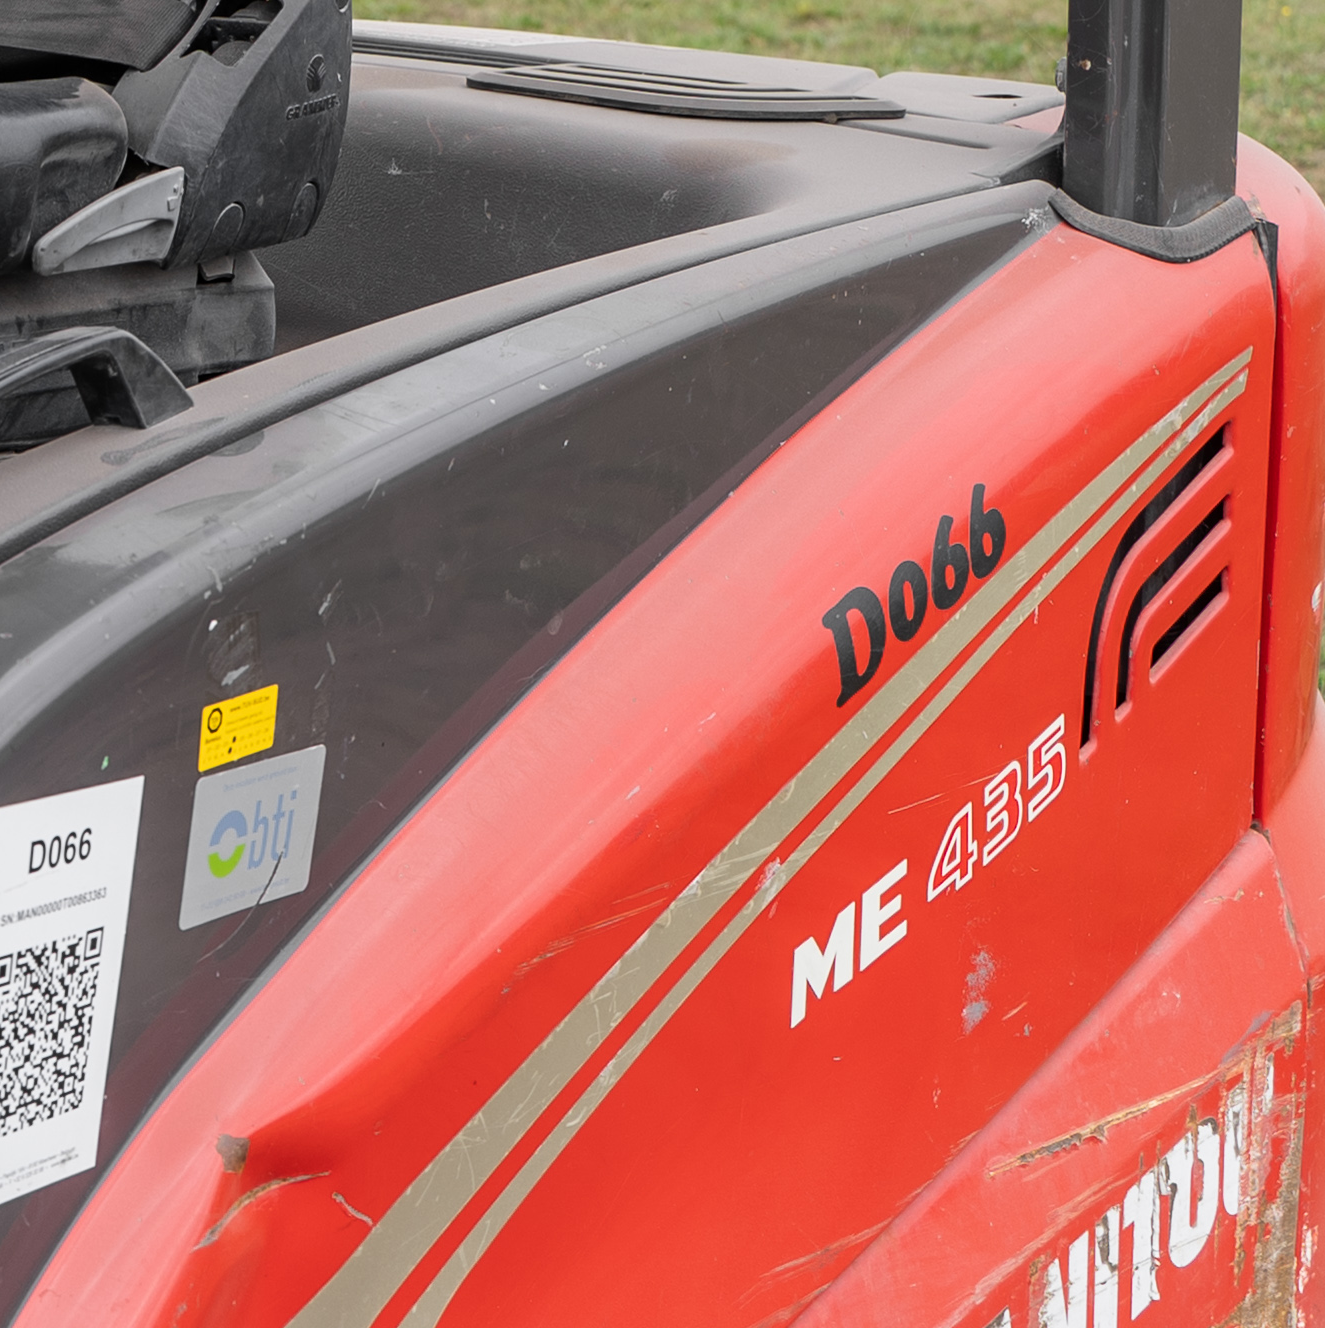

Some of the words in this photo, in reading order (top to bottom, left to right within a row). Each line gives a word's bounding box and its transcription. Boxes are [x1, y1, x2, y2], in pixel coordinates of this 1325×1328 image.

[28, 827, 92, 874] D066
[790, 858, 908, 1029] ME
[926, 713, 1067, 903] 435
